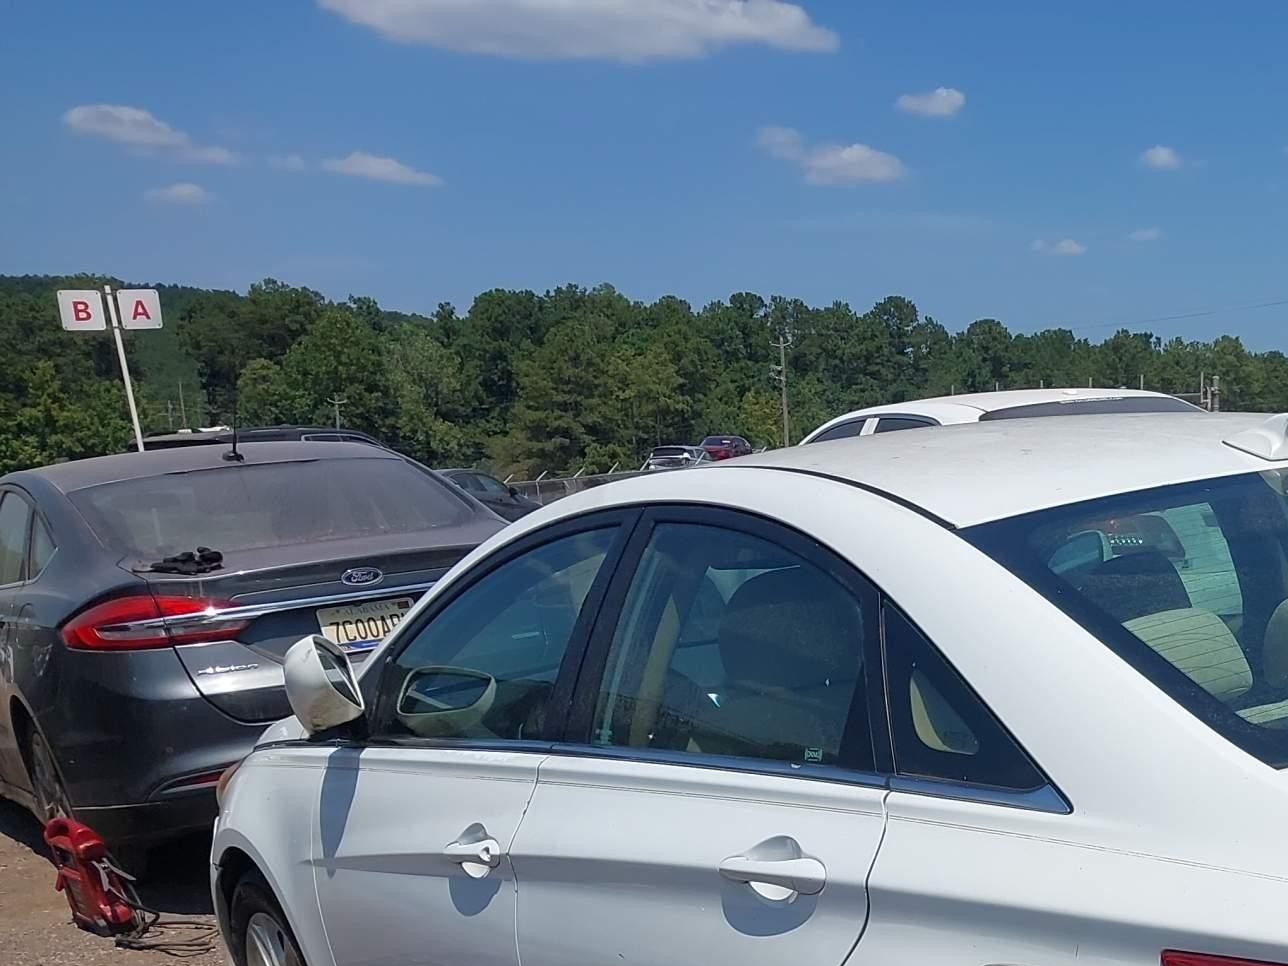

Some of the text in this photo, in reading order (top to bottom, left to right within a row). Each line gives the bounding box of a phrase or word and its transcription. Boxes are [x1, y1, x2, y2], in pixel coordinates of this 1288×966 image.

[72, 300, 92, 322] B
[132, 299, 152, 321] A
[351, 571, 374, 583] Ford
